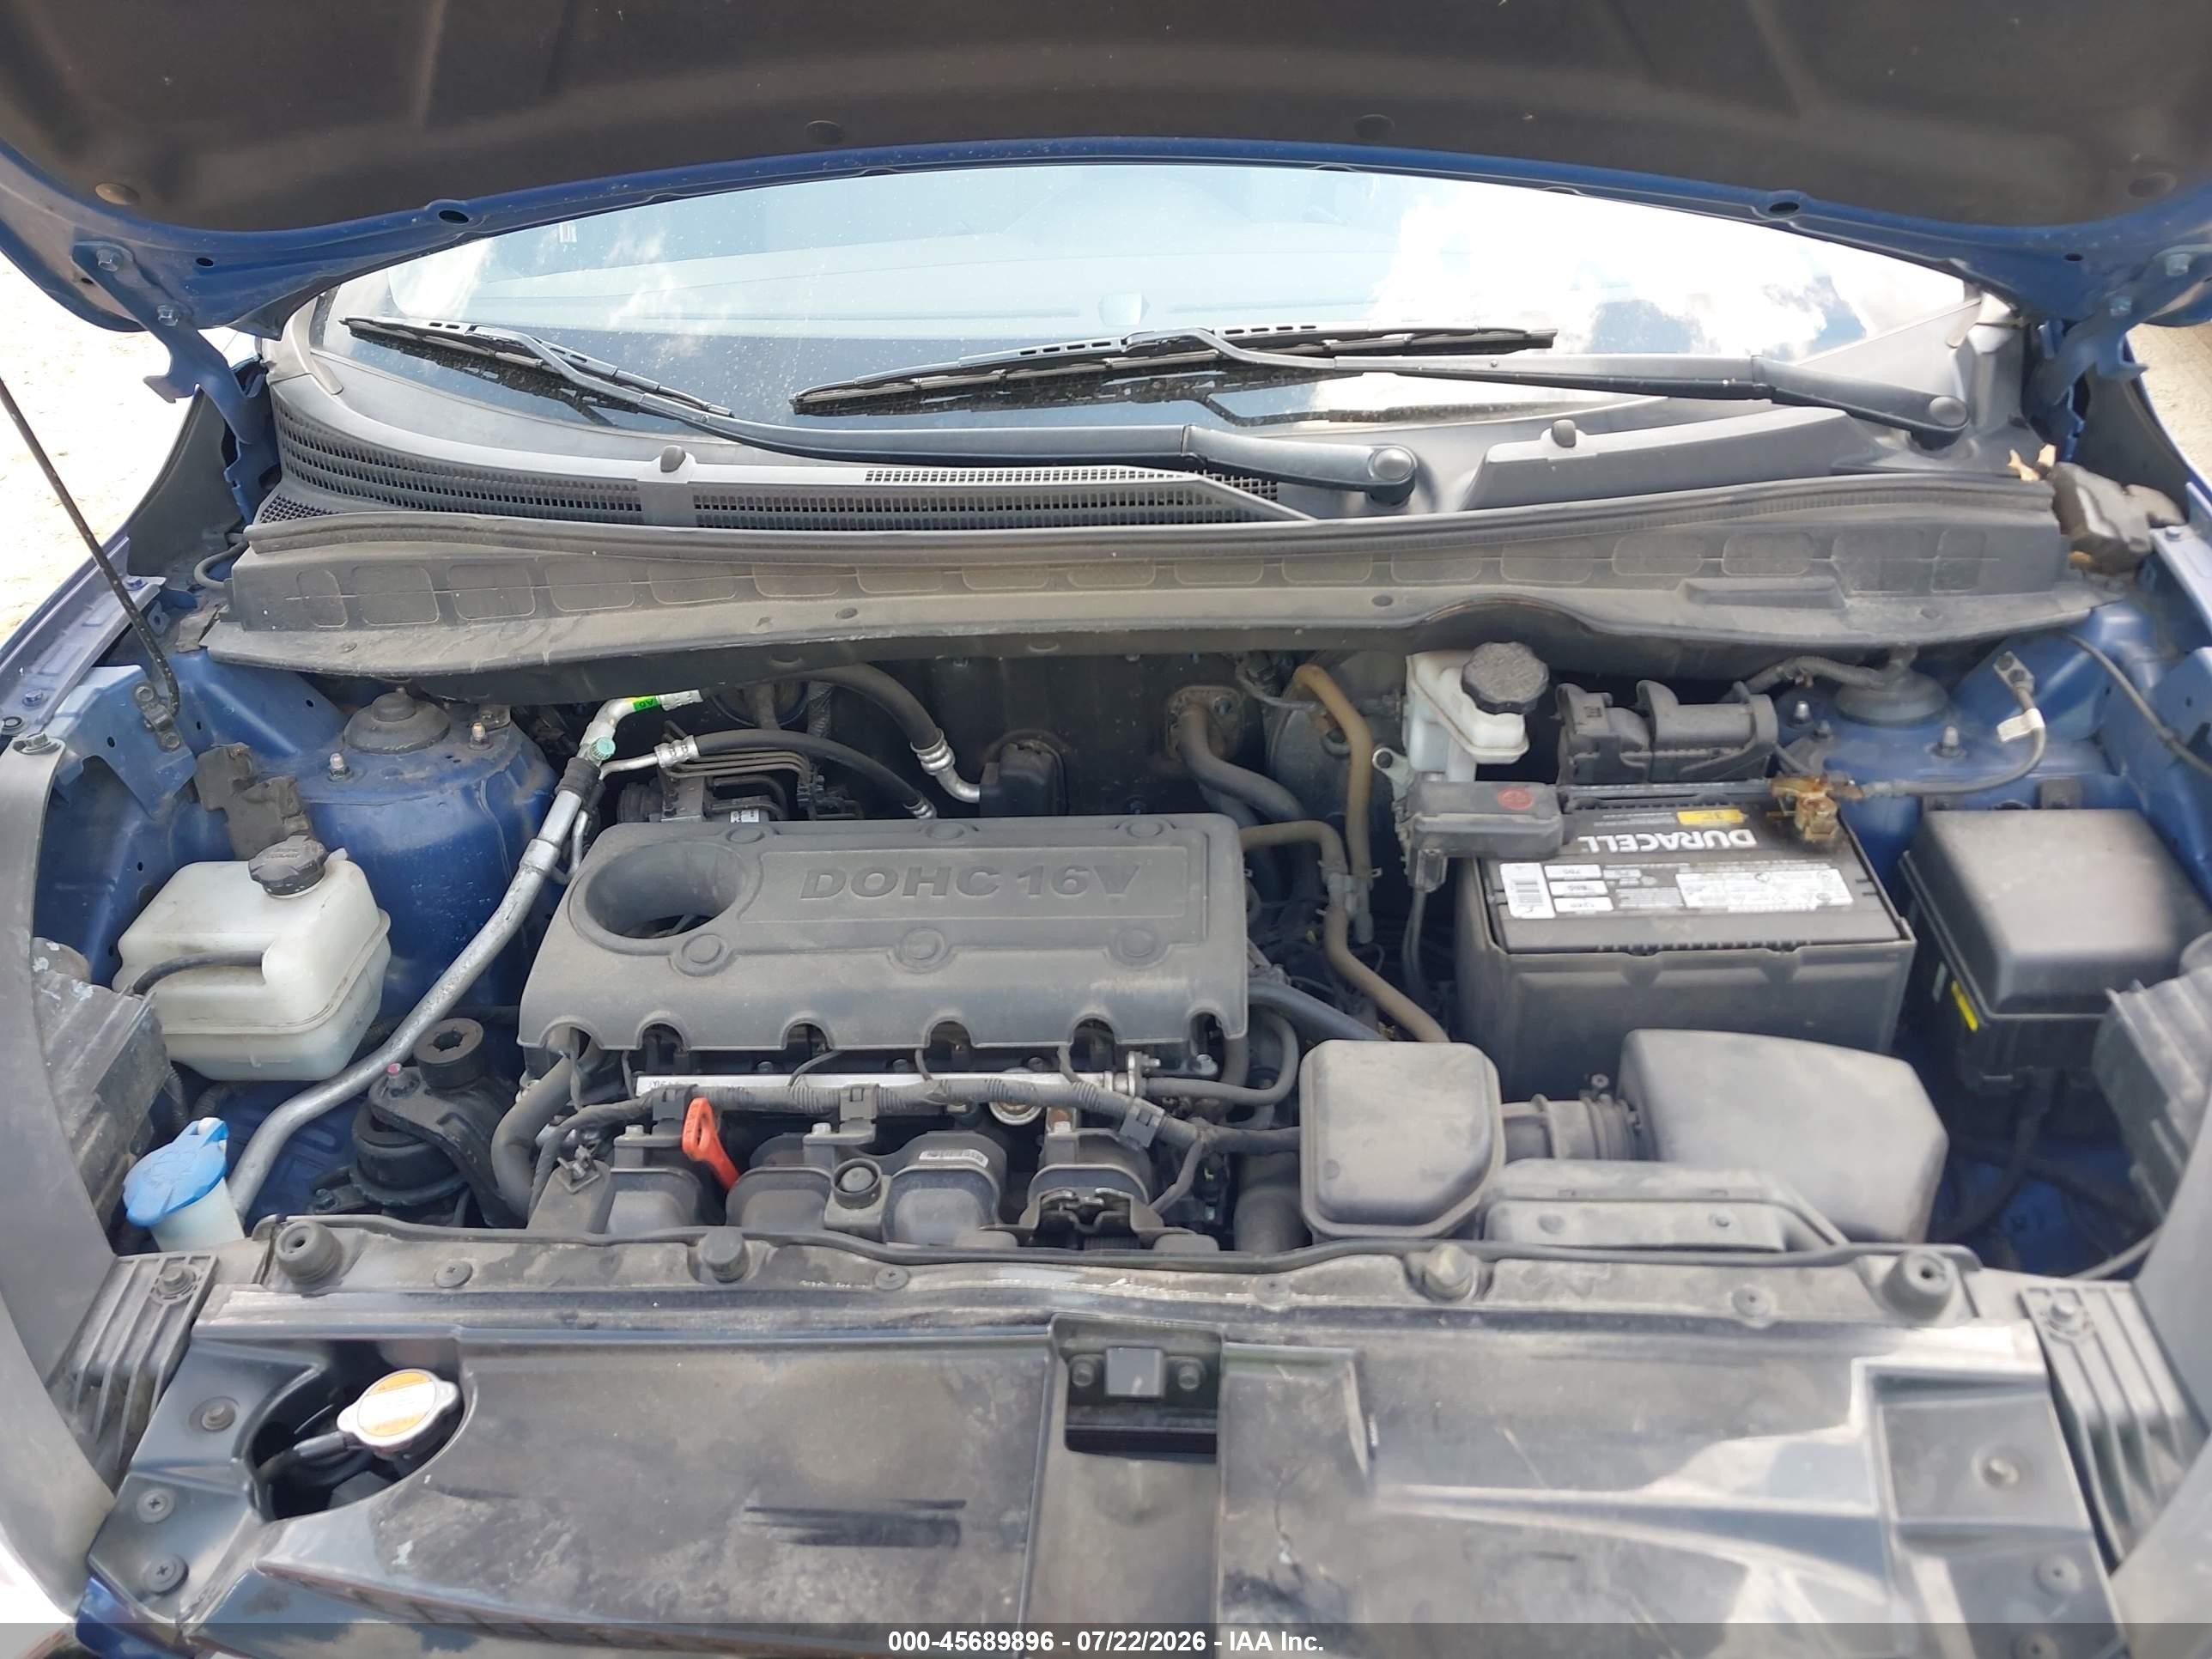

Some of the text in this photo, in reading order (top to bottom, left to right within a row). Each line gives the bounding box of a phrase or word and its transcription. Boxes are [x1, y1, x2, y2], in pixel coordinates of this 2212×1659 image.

[1577, 829, 1757, 853] DURACELL
[800, 865, 1141, 899] DOHC 16V
